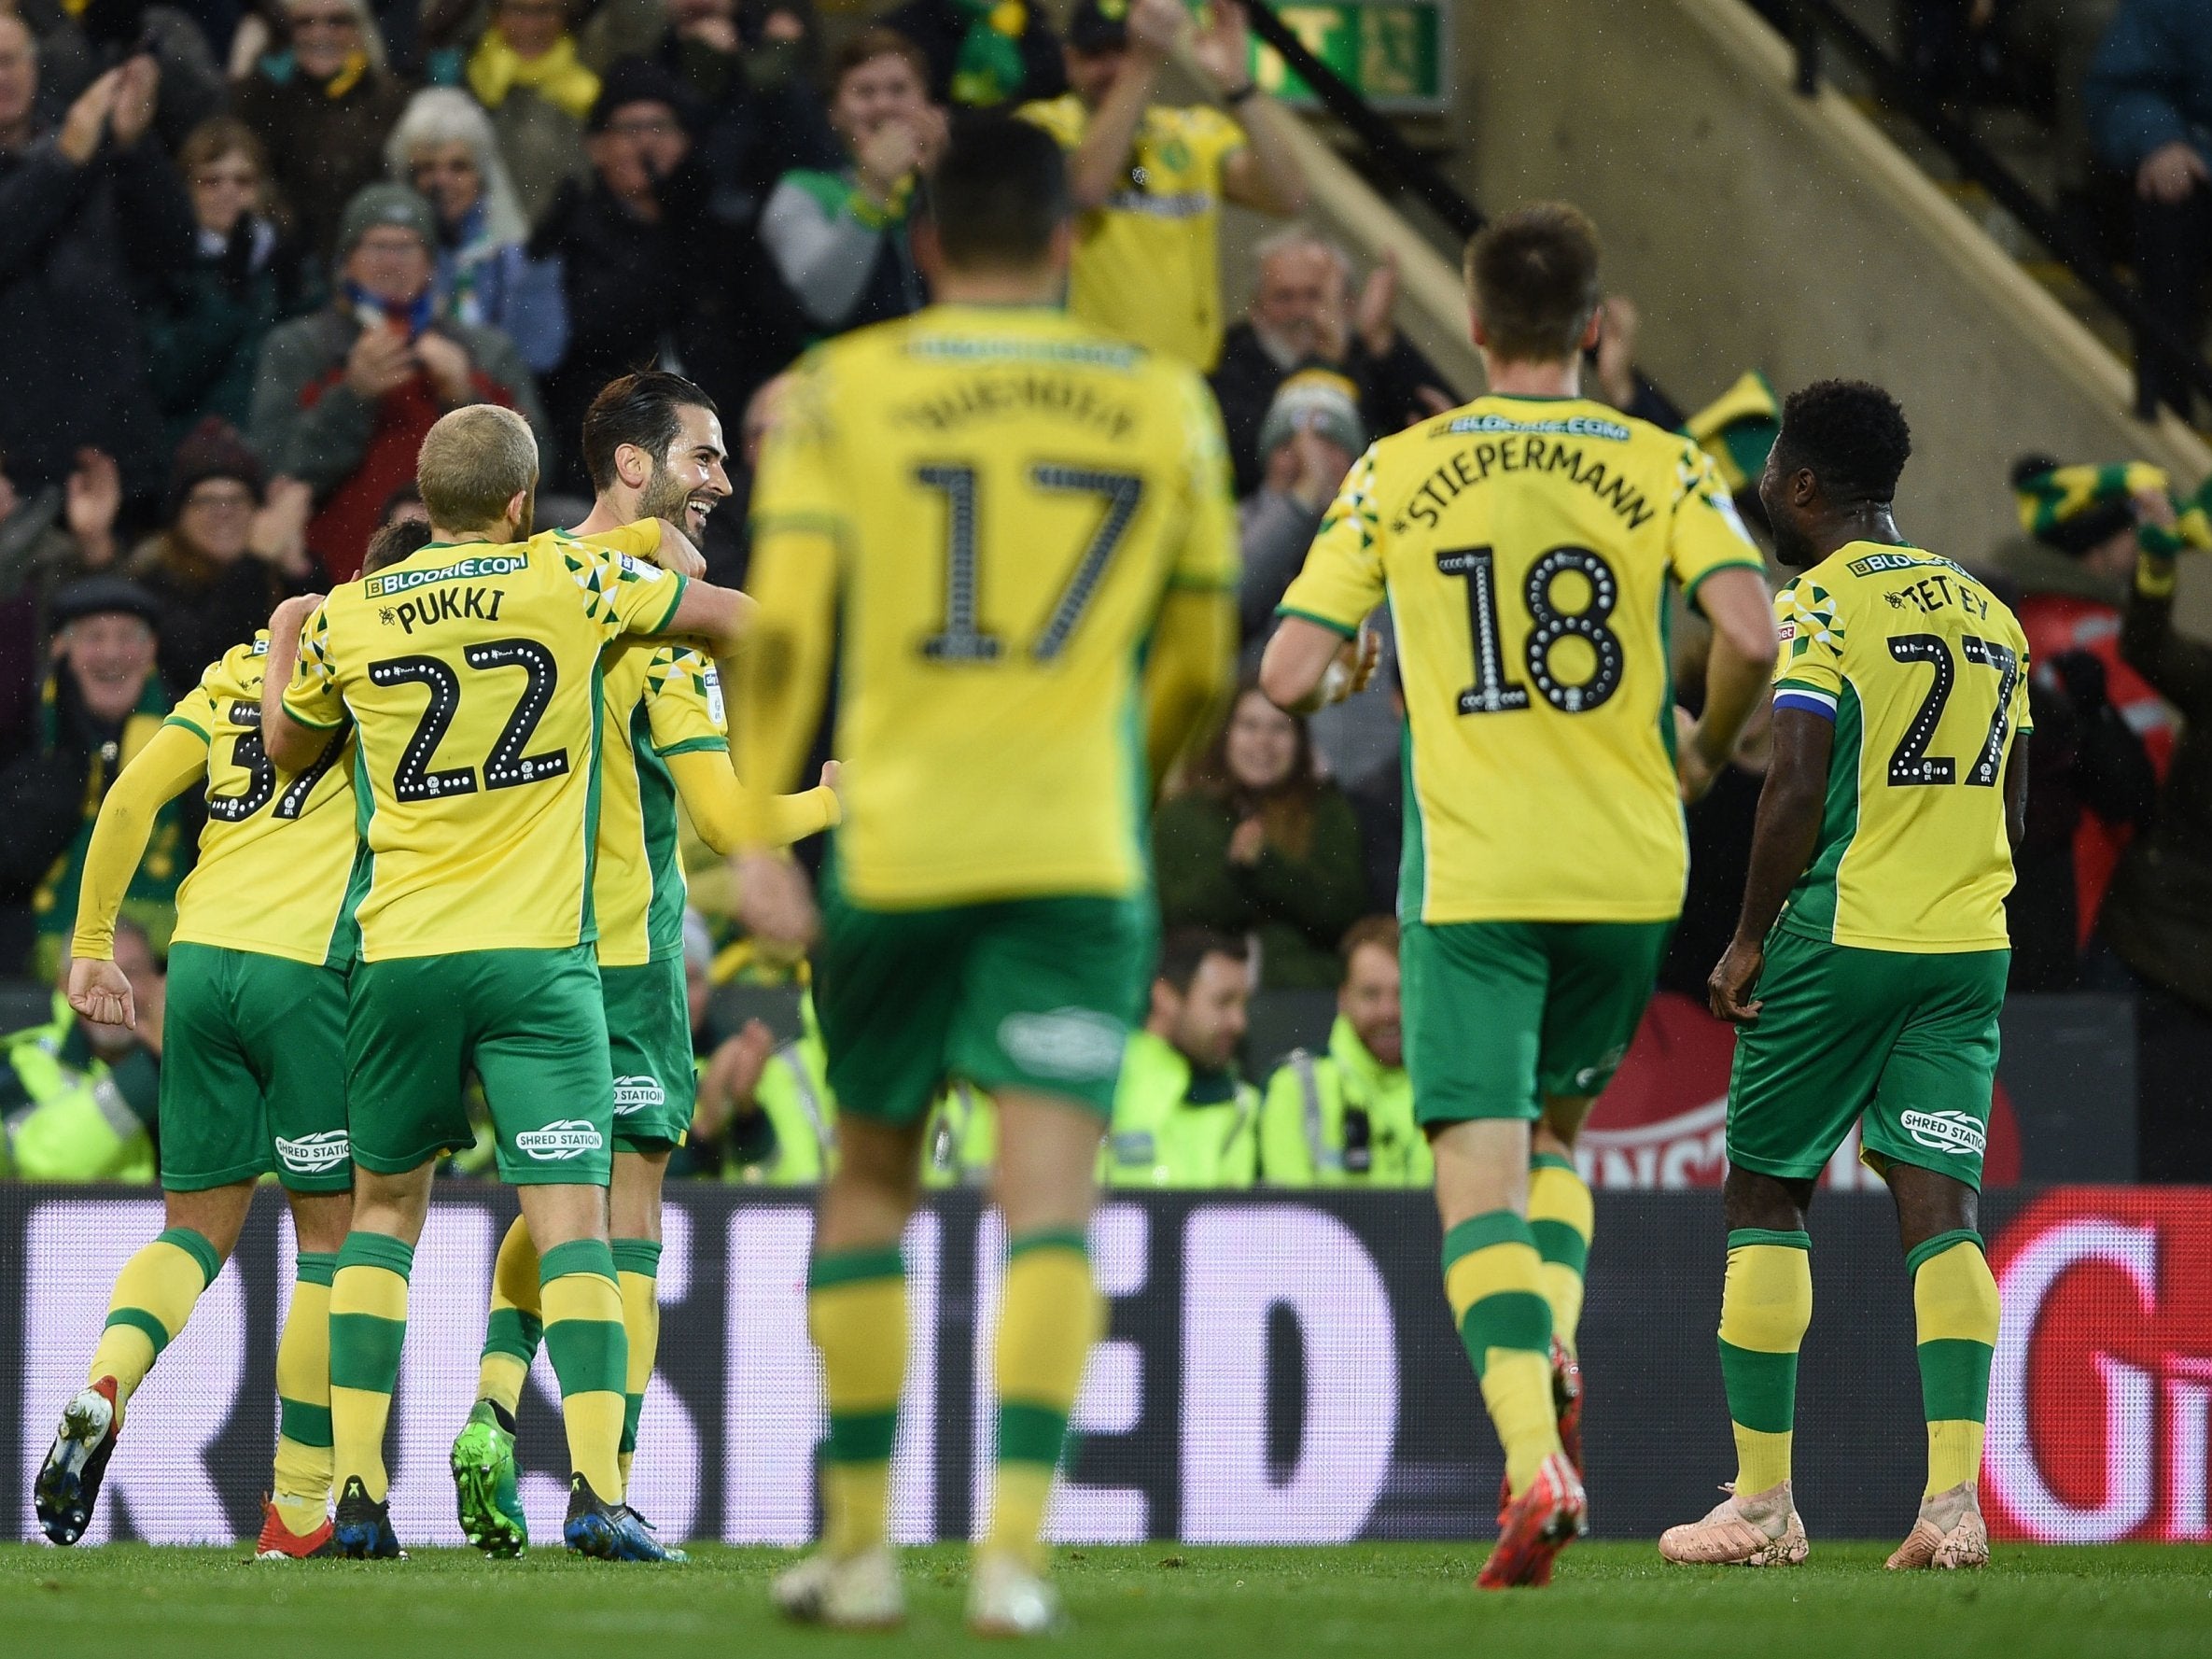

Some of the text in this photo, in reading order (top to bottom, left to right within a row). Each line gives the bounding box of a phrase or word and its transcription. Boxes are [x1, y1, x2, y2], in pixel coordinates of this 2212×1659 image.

[1408, 435, 1654, 530] STIEPERMANN
[384, 553, 526, 594] BLOORIE.COM
[917, 465, 1142, 660] 17
[396, 586, 505, 635] PUKKI
[1901, 575, 1988, 621] TETEY
[1436, 544, 1624, 715] 18
[368, 638, 569, 803] 22
[1886, 634, 2017, 787] 27
[621, 1090, 663, 1102] STATION
[520, 1134, 600, 1146] SHRED STATION
[1905, 1114, 1948, 1133] SHRED
[278, 1141, 351, 1158] SHRED STATIO
